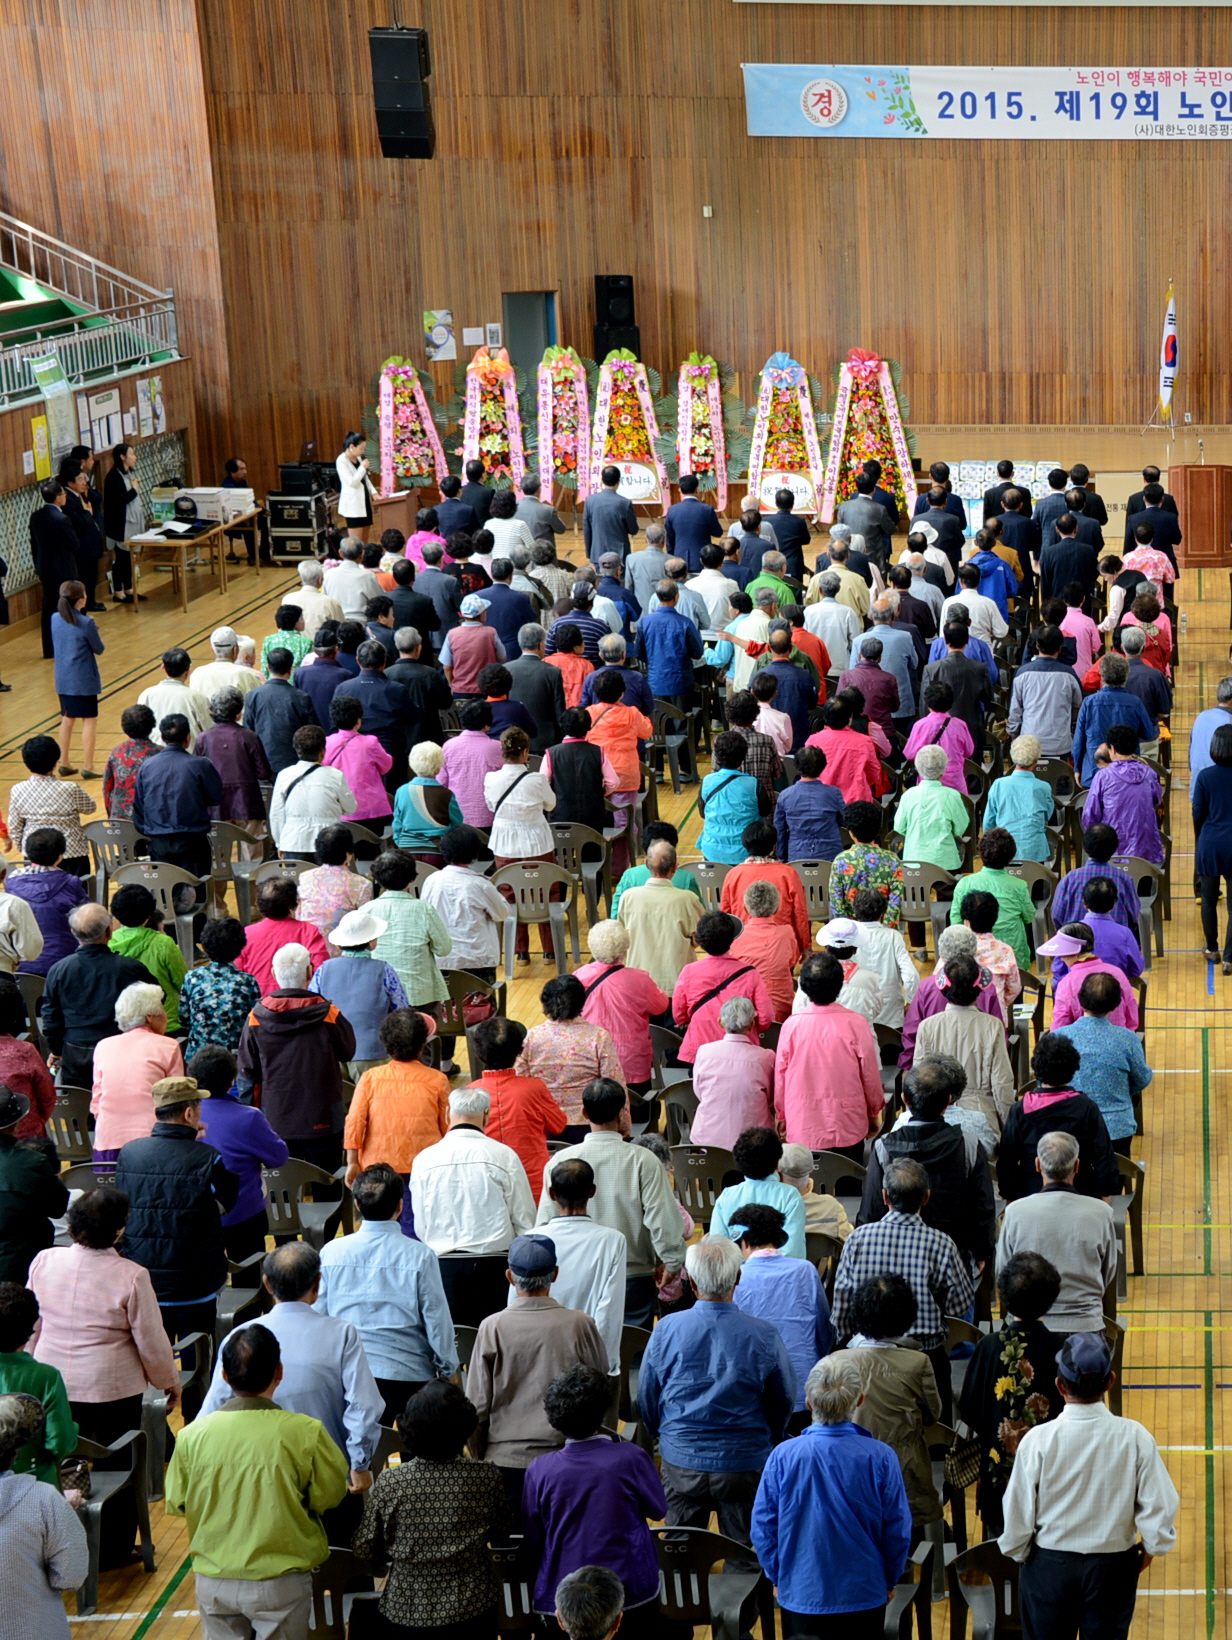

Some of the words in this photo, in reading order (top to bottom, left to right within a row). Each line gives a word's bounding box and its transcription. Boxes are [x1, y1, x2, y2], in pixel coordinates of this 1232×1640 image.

[1076, 70, 1120, 87] 노인이
[1127, 70, 1188, 87] 행복해야
[812, 89, 833, 117] 경
[937, 91, 1037, 121] 2015.
[1054, 90, 1159, 122] 제19회
